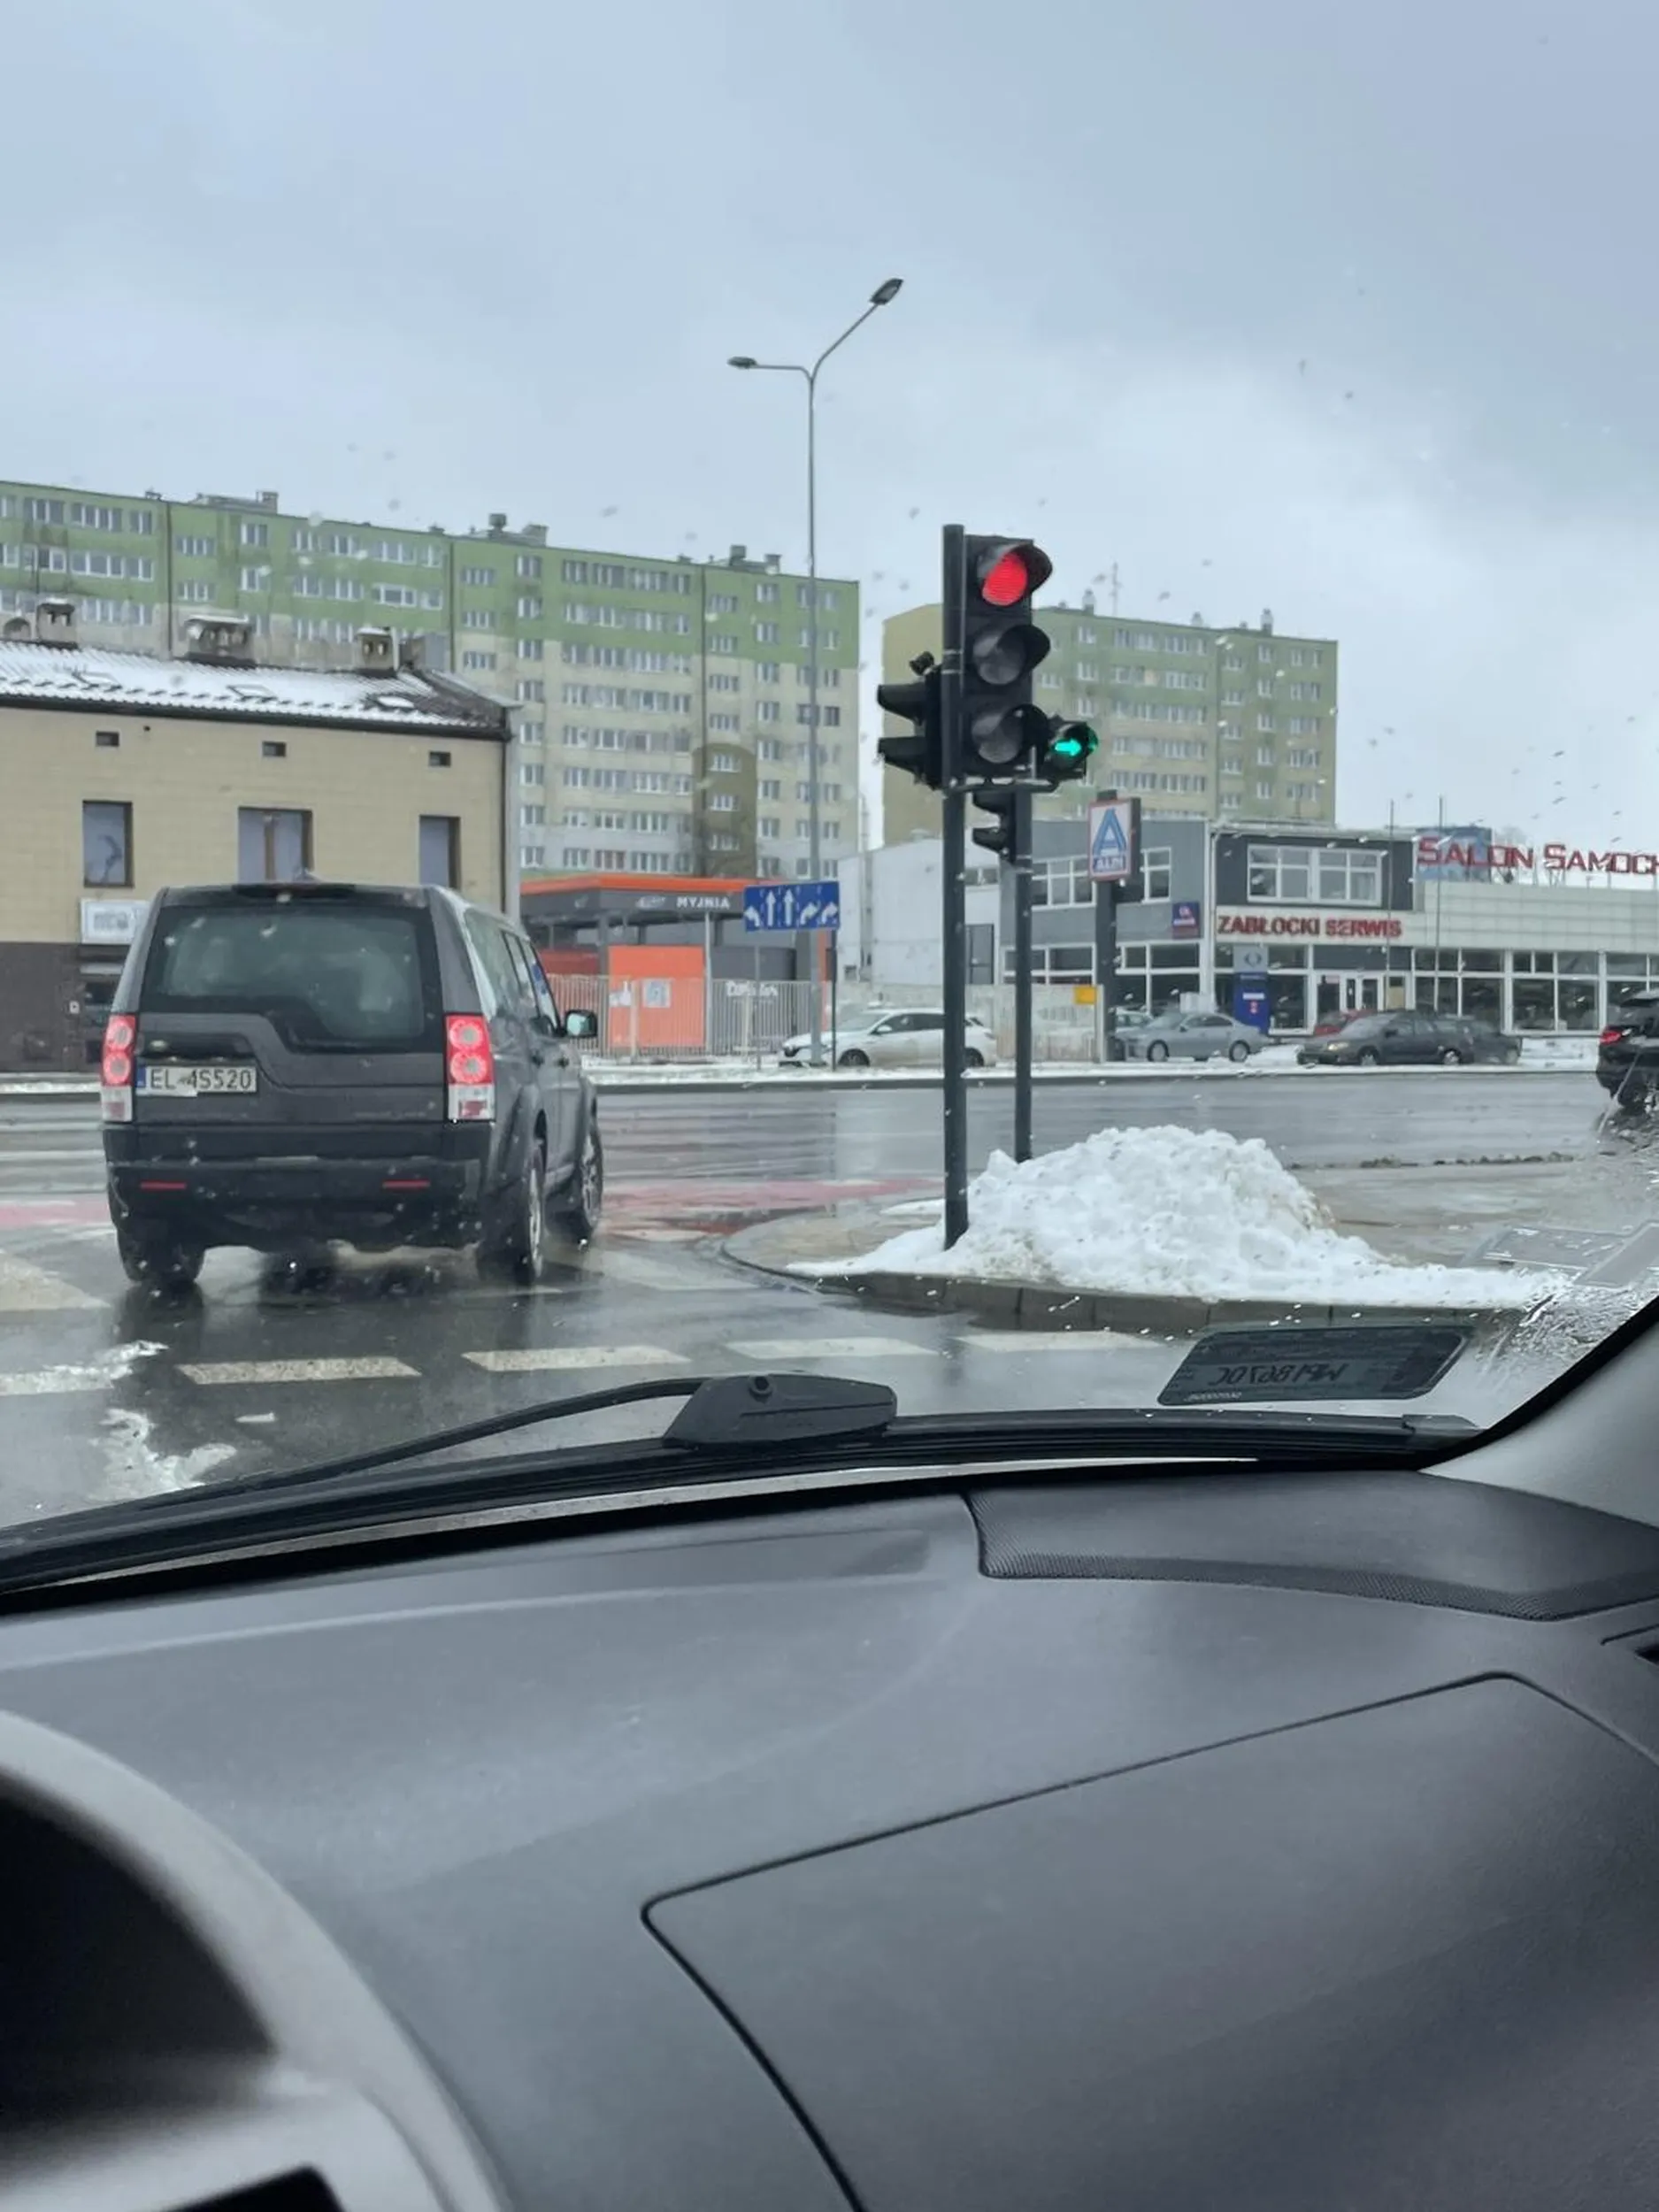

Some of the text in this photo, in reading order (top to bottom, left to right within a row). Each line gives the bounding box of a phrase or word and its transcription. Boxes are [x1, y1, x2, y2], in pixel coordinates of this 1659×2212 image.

[1417, 836, 1533, 868] SALON
[1094, 856, 1126, 870] ALDI
[676, 895, 730, 910] MYJNIA
[1325, 918, 1402, 938] SERWIS
[150, 1068, 177, 1090] EL
